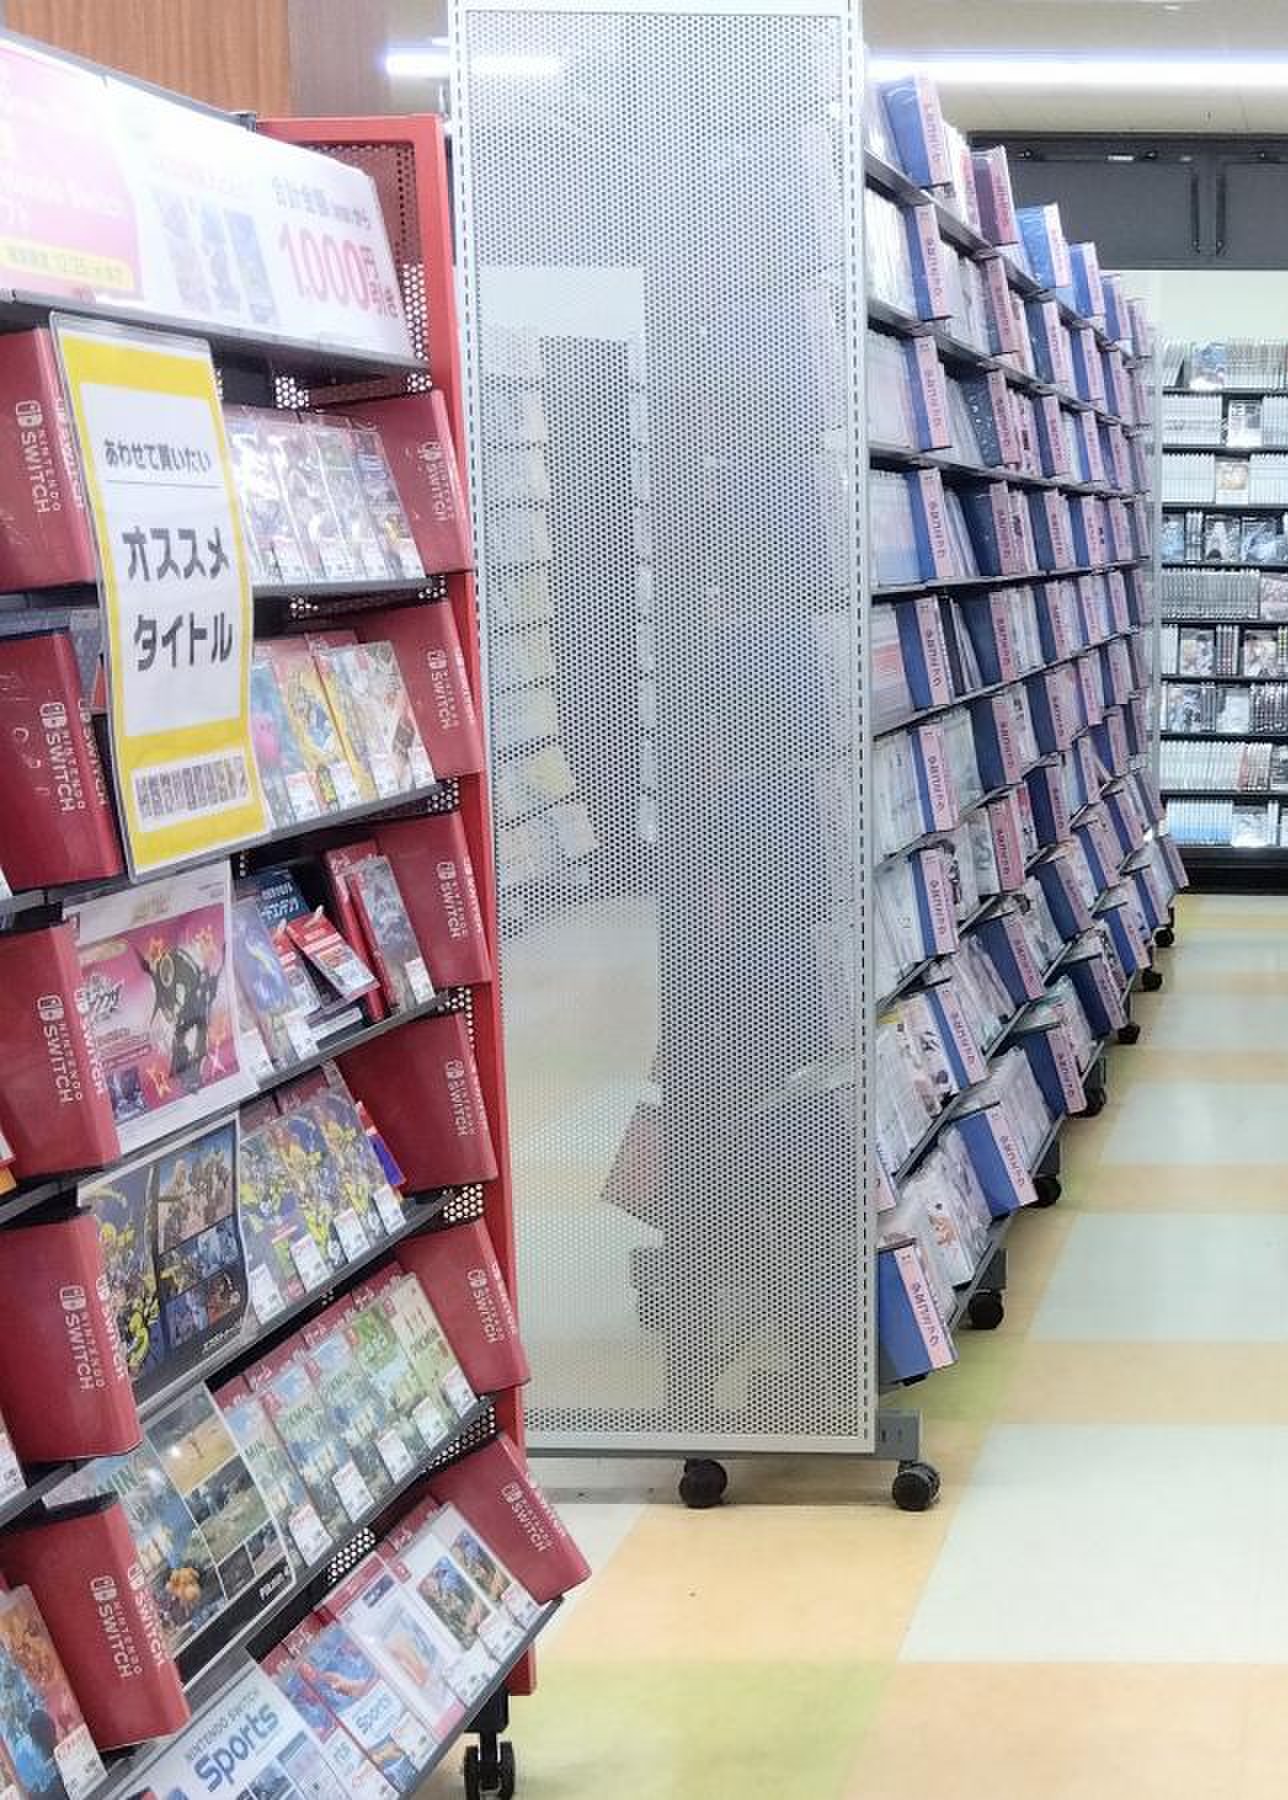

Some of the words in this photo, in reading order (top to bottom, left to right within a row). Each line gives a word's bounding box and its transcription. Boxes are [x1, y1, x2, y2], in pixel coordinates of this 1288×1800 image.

[21, 432, 50, 512] SWITCH
[103, 439, 212, 475] あわせて買いたい
[122, 524, 229, 581] オススメ
[134, 611, 233, 672] タイトル
[47, 733, 75, 811] SWITCH
[43, 1024, 73, 1103] SWITCH
[65, 1313, 95, 1390] SWITCH
[98, 1604, 132, 1678] SWITCH
[195, 1704, 281, 1793] Sports
